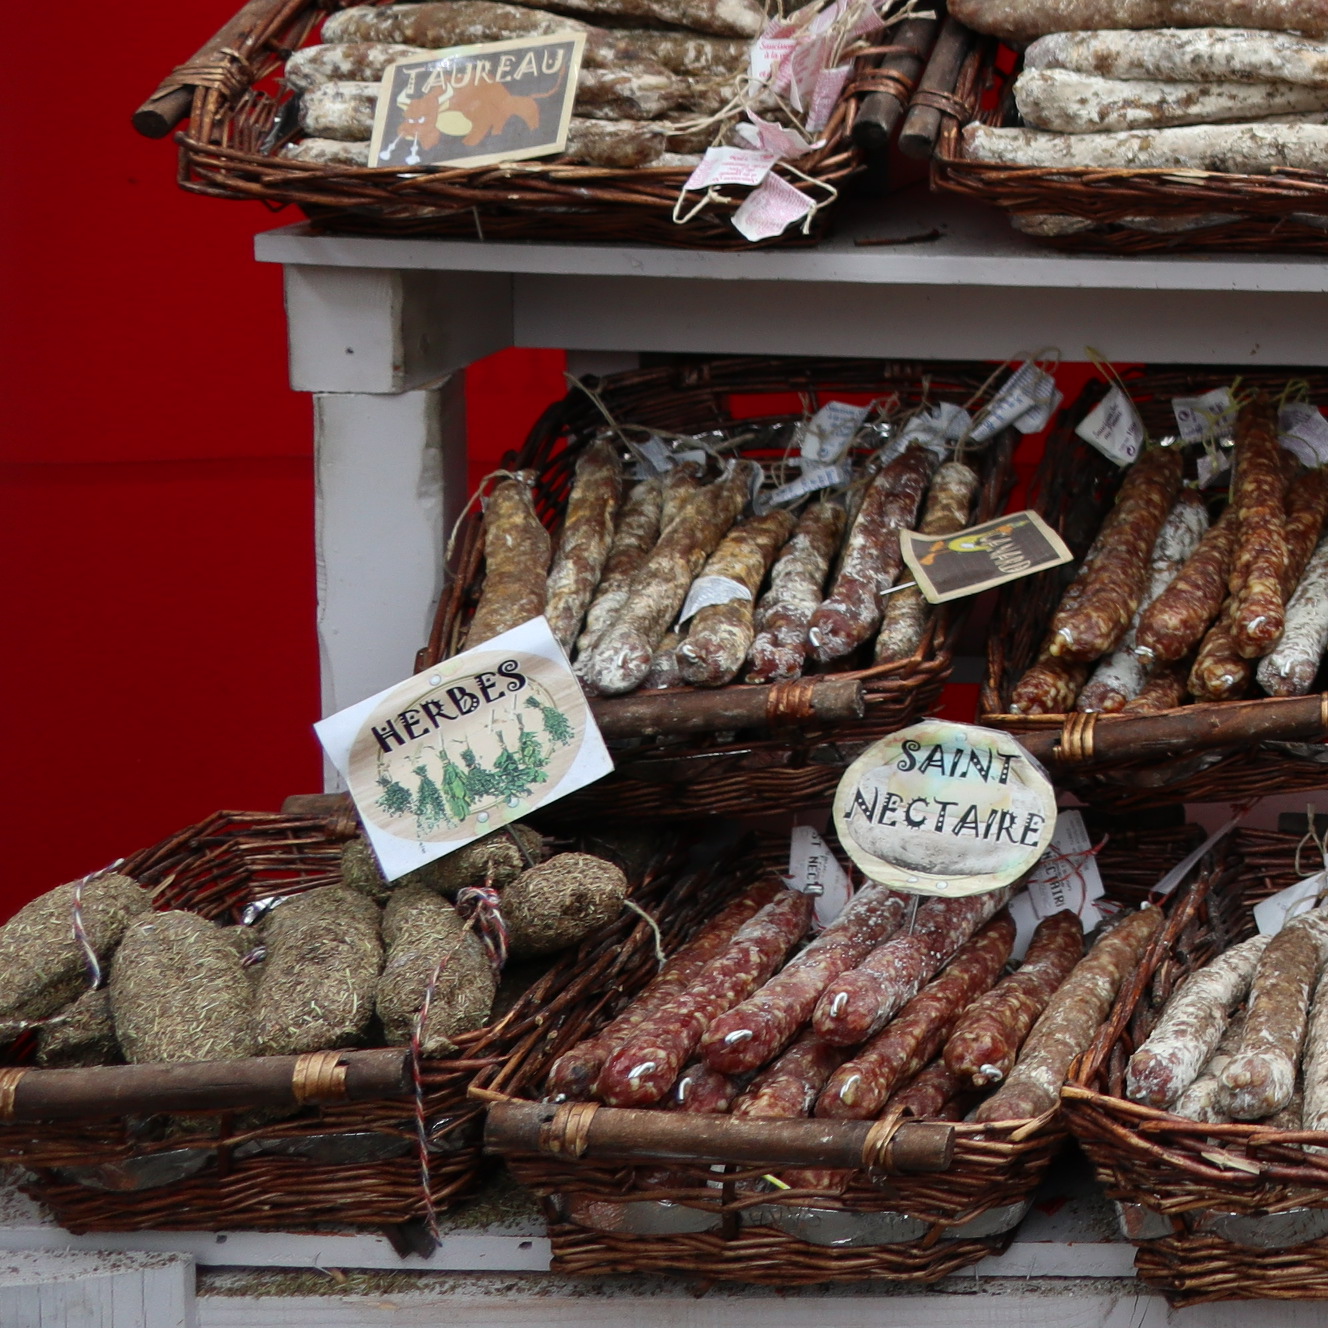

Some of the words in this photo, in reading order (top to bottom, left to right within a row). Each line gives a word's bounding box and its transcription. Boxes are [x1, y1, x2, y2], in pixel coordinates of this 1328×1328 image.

[401, 47, 566, 98] TAUREAU
[370, 658, 528, 755] HERBES
[896, 738, 1023, 786] SAINT
[843, 785, 1046, 849] NECTAIRE
